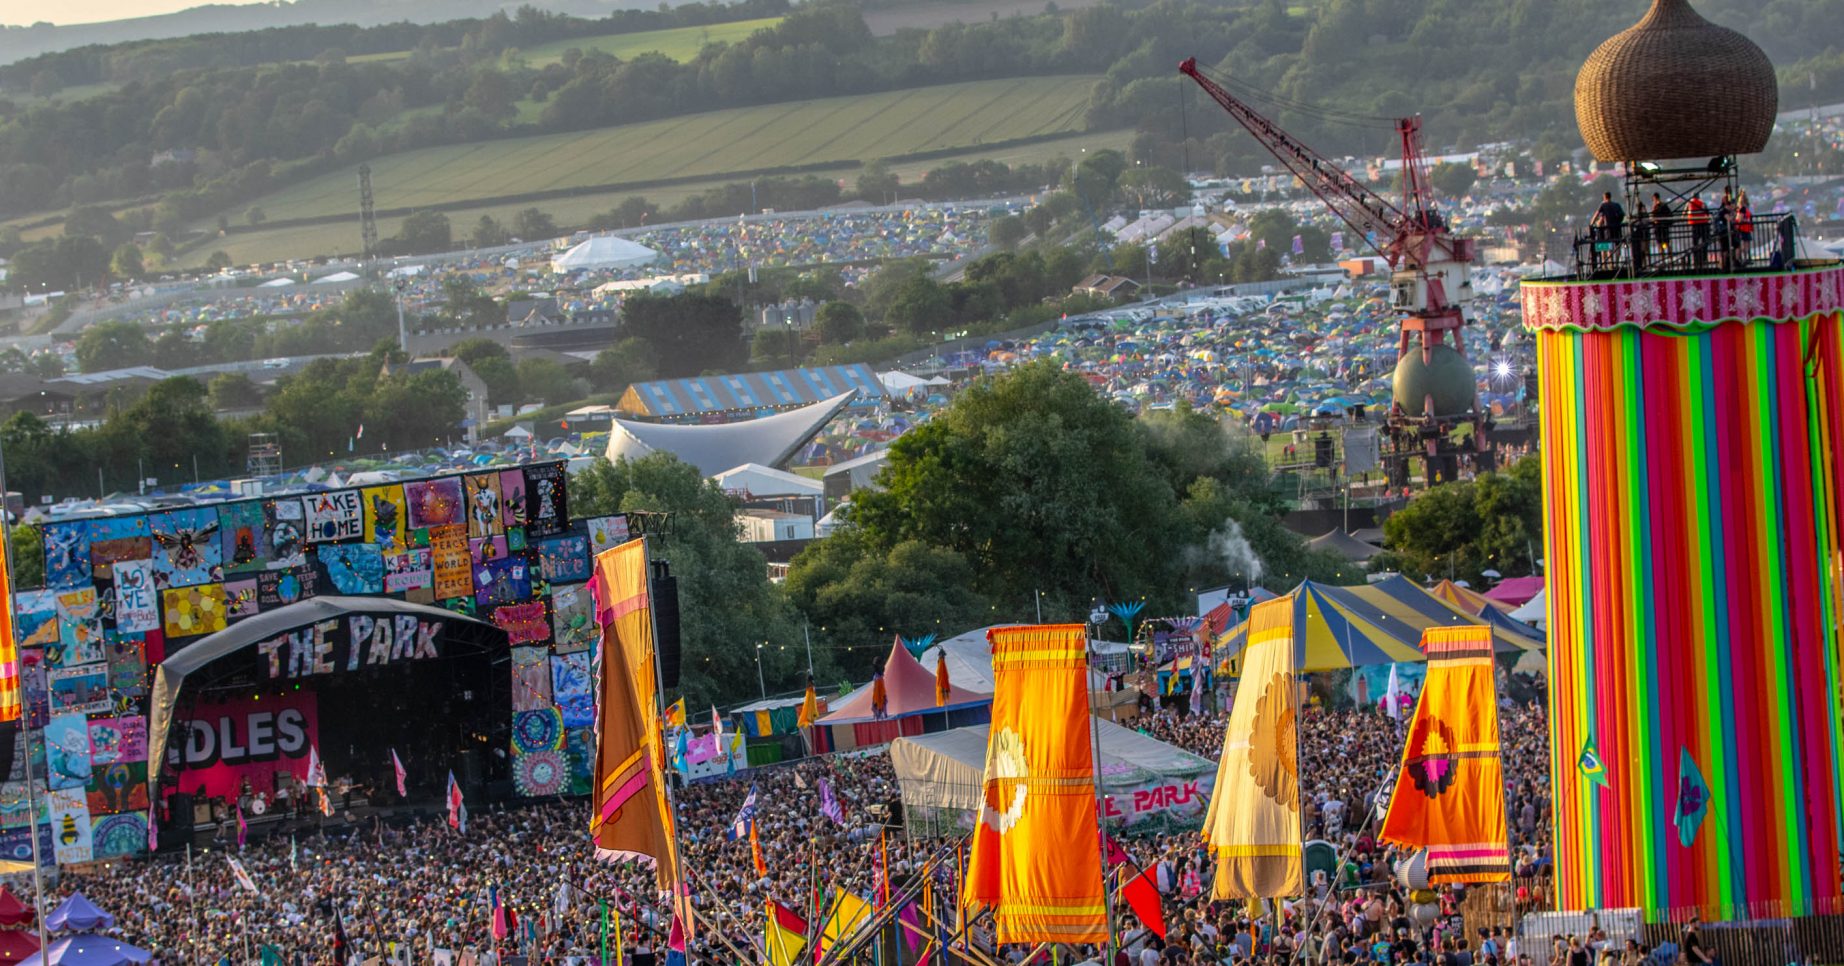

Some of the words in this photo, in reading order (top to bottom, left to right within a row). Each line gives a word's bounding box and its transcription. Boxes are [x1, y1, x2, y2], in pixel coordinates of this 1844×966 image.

[307, 493, 357, 513] TAKE
[311, 518, 360, 539] HOME
[436, 558, 468, 569] WORLD
[259, 573, 279, 583] SAVE
[437, 578, 470, 590] PEACE
[258, 619, 339, 679] THE
[346, 614, 443, 671] PARK
[1161, 642, 1197, 656] T-SHIR
[1134, 780, 1198, 813] PARK
